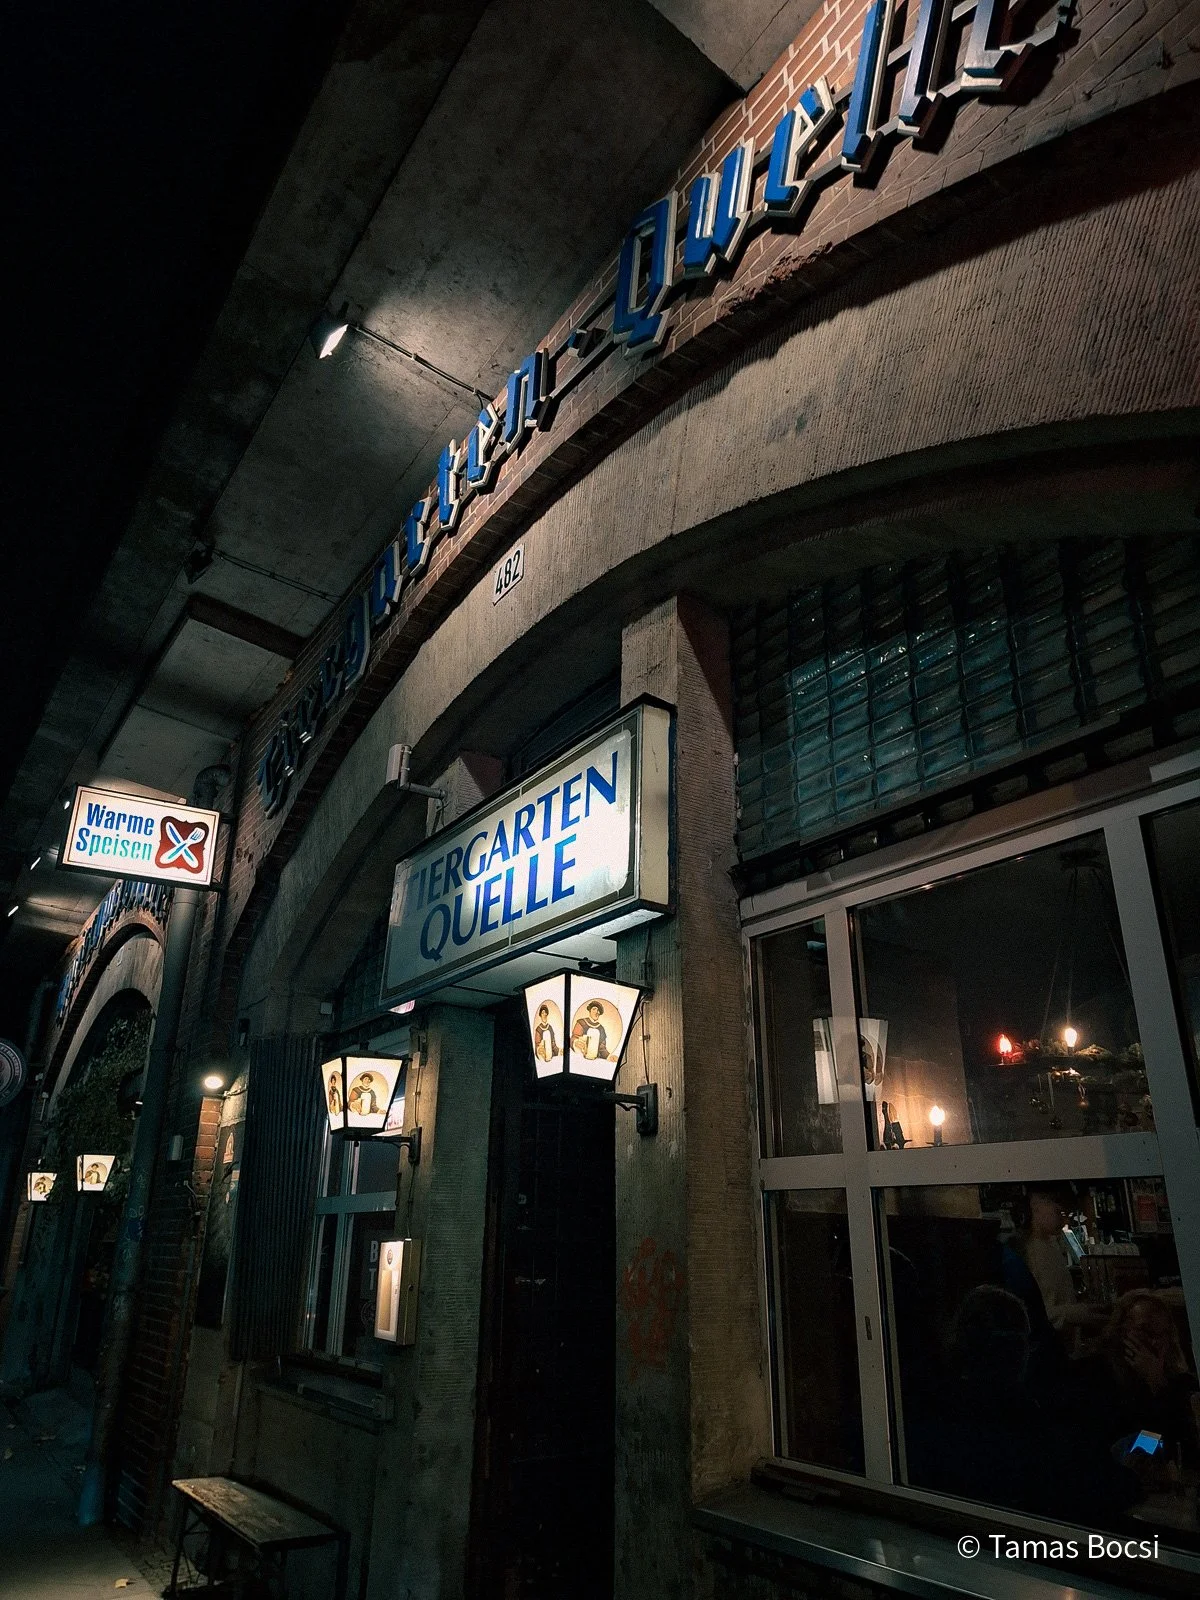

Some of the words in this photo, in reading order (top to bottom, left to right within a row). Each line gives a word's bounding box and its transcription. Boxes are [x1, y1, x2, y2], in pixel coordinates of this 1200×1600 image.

[495, 549, 521, 595] 482
[86, 802, 155, 836] Warme
[408, 750, 619, 911] TIERGARTEN
[75, 827, 153, 861] Speisen
[420, 834, 577, 962] QUELLE
